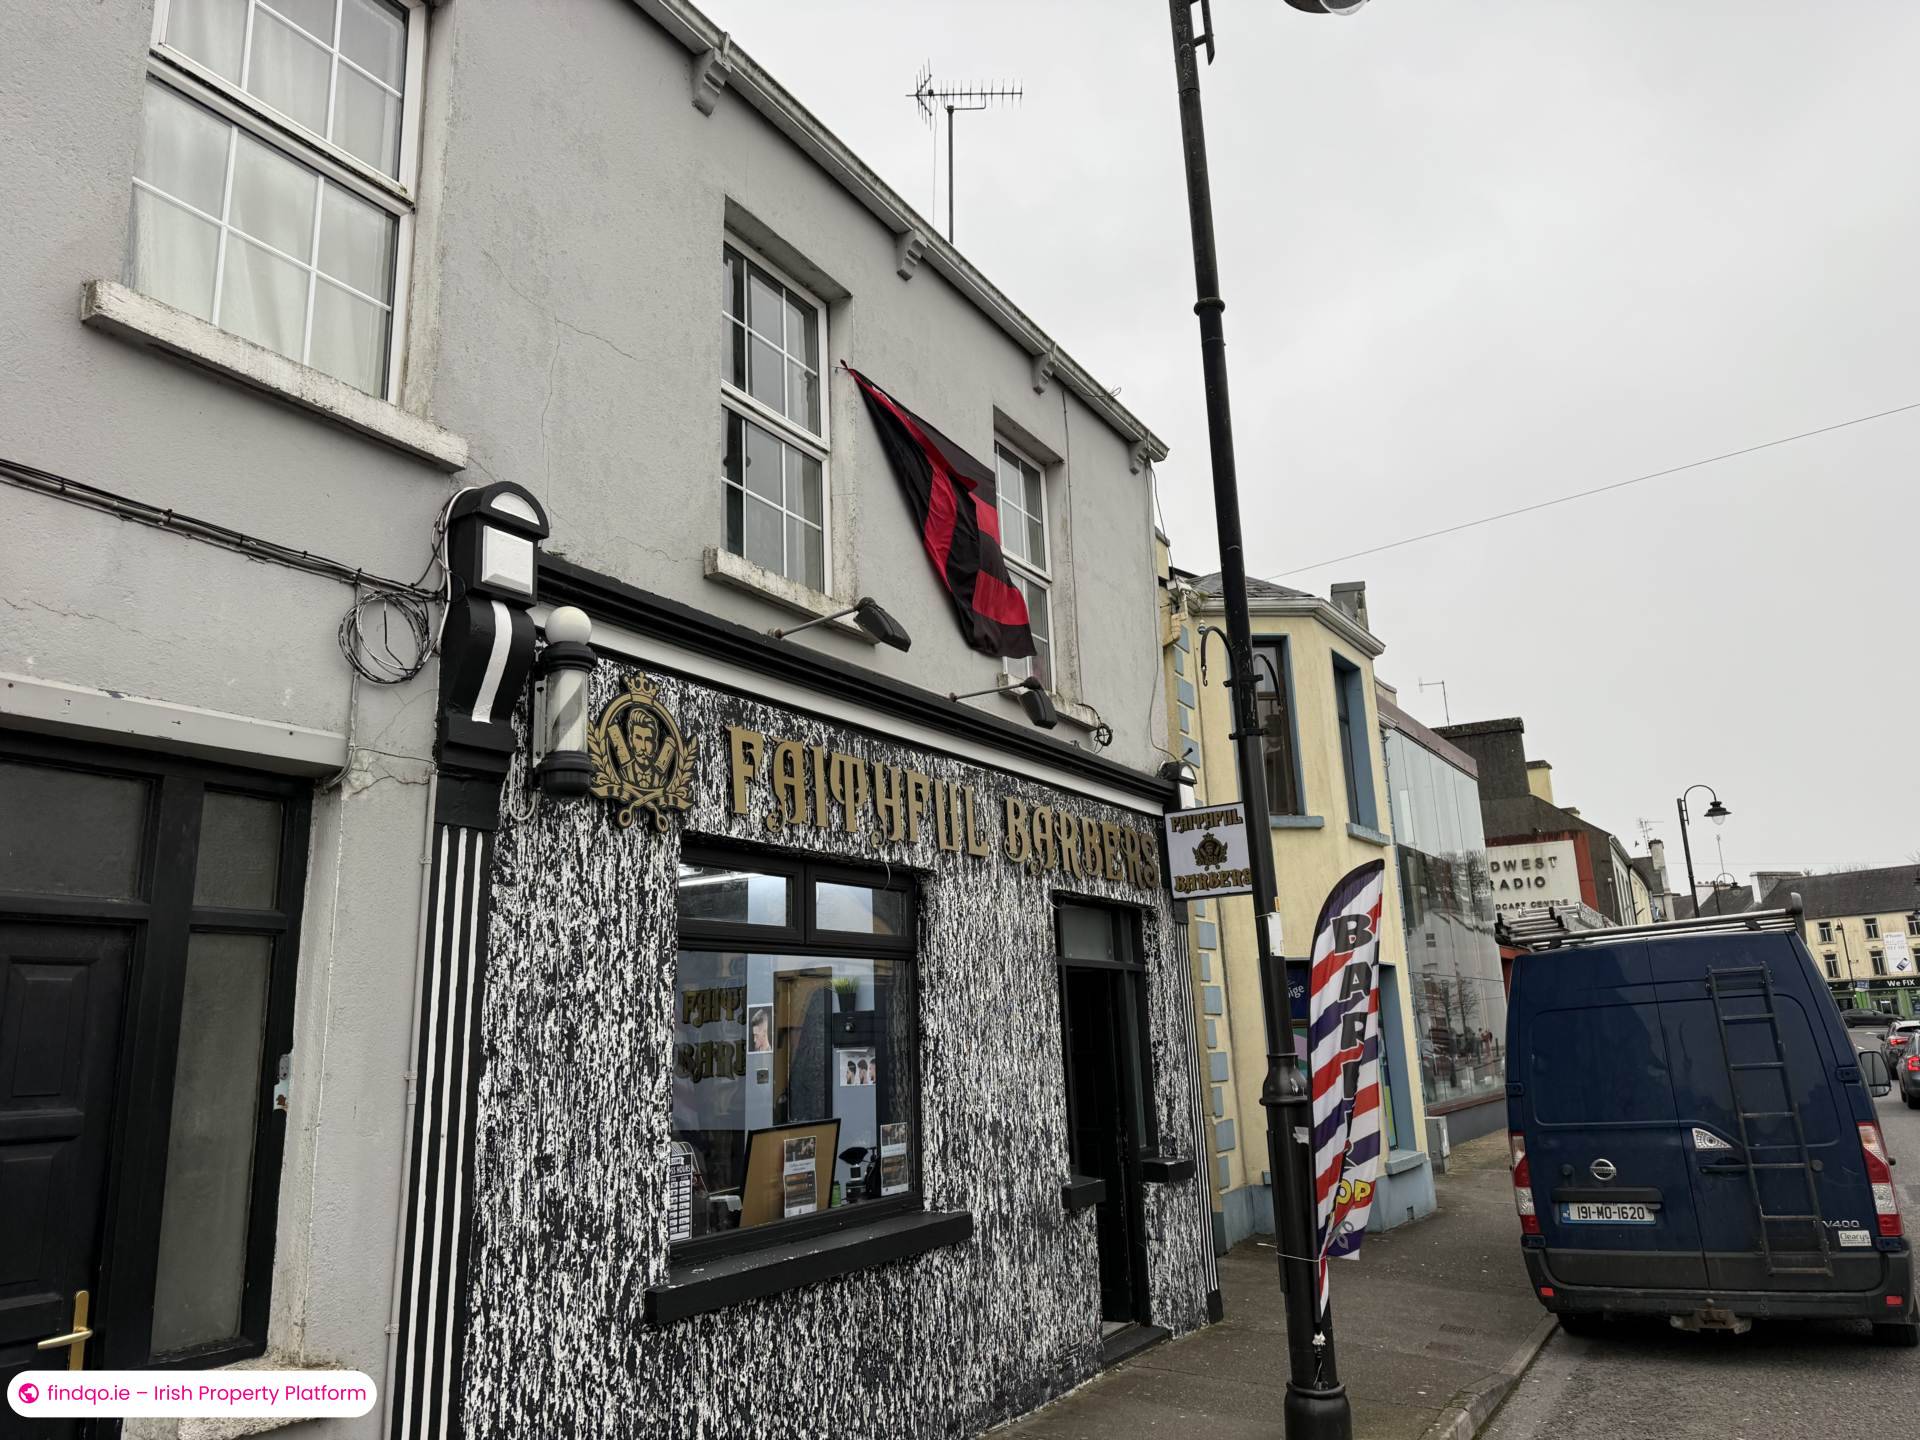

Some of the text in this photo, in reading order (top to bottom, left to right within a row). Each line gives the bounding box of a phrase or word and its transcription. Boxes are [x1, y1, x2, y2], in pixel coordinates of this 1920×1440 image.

[724, 725, 1159, 889] FAITHFUL BARBERS
[1170, 808, 1244, 834] FAITHFUL
[1490, 856, 1557, 873] DWEST
[1174, 868, 1252, 894] BARBERS
[1288, 985, 1305, 999] ige
[681, 985, 748, 1028] FAIT
[1577, 1206, 1645, 1220] 191-MO-1620
